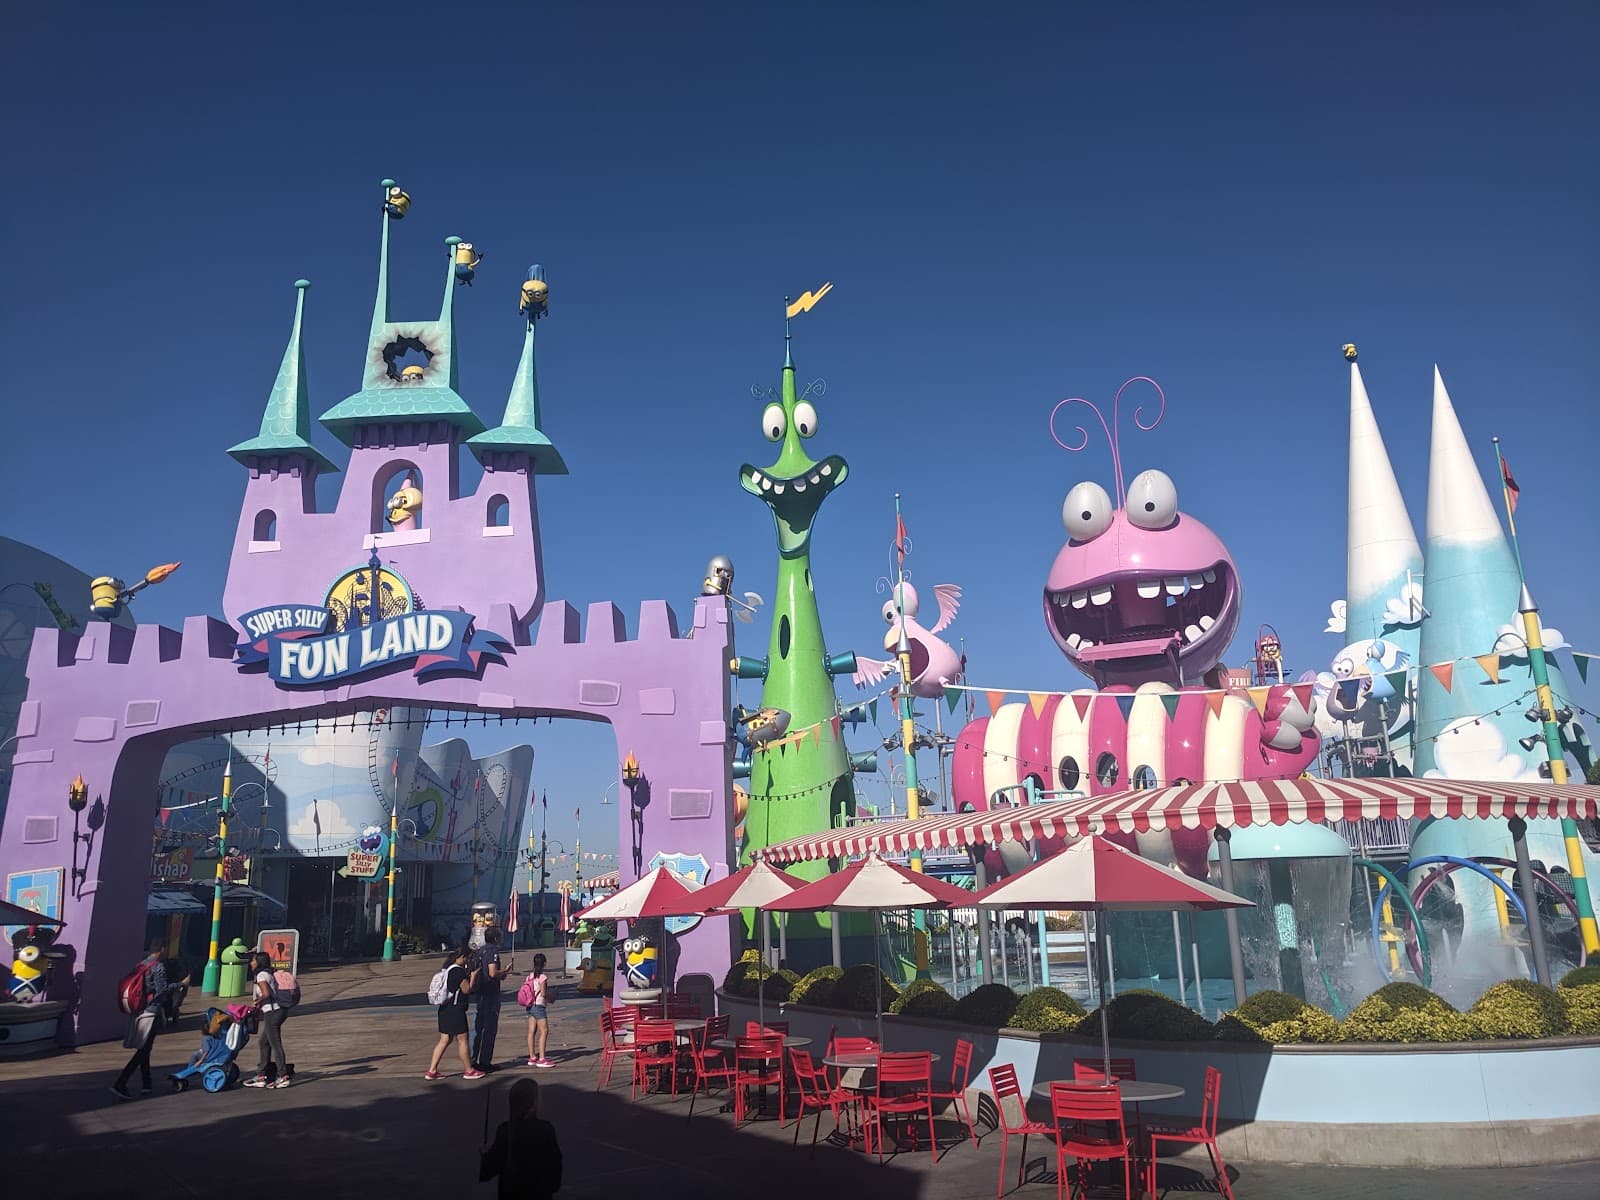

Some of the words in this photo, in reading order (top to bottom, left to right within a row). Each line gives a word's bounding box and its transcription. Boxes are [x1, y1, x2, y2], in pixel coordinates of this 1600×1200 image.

[246, 608, 292, 638] SUPER
[294, 608, 328, 629] SILLY
[280, 635, 350, 679] FUN
[360, 614, 453, 668] LAND
[350, 853, 378, 862] SUPER
[152, 859, 188, 878] ishap
[350, 866, 375, 874] STUFF
